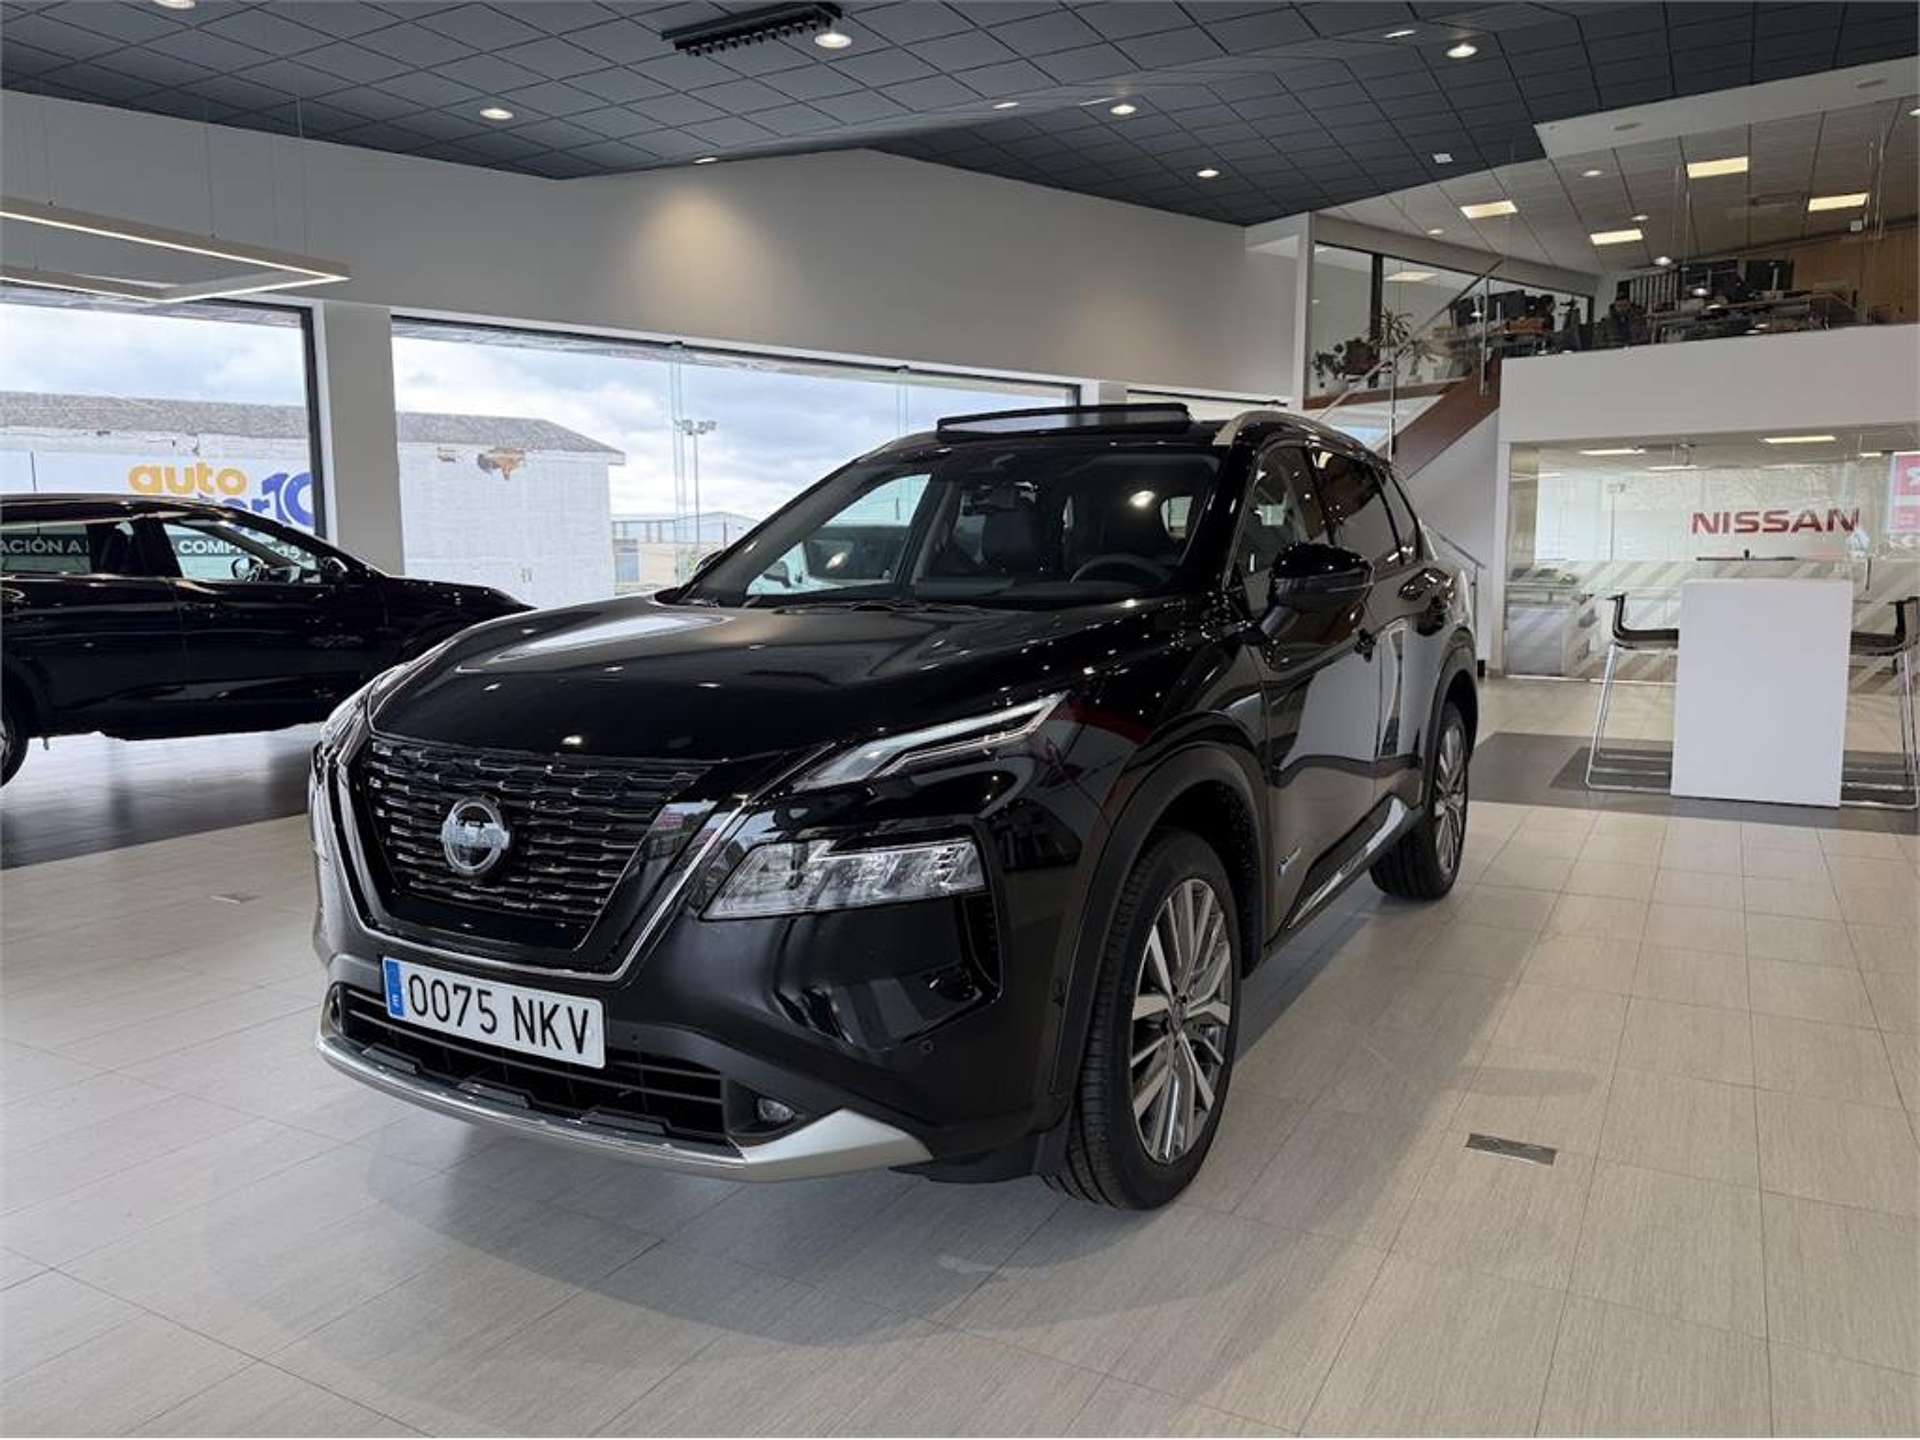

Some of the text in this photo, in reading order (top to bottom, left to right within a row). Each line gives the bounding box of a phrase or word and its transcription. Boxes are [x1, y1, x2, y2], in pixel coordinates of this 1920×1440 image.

[128, 463, 247, 496] auto
[1691, 508, 1859, 535] NISSAN
[408, 974, 498, 1034] 0075
[511, 995, 589, 1054] NKV
